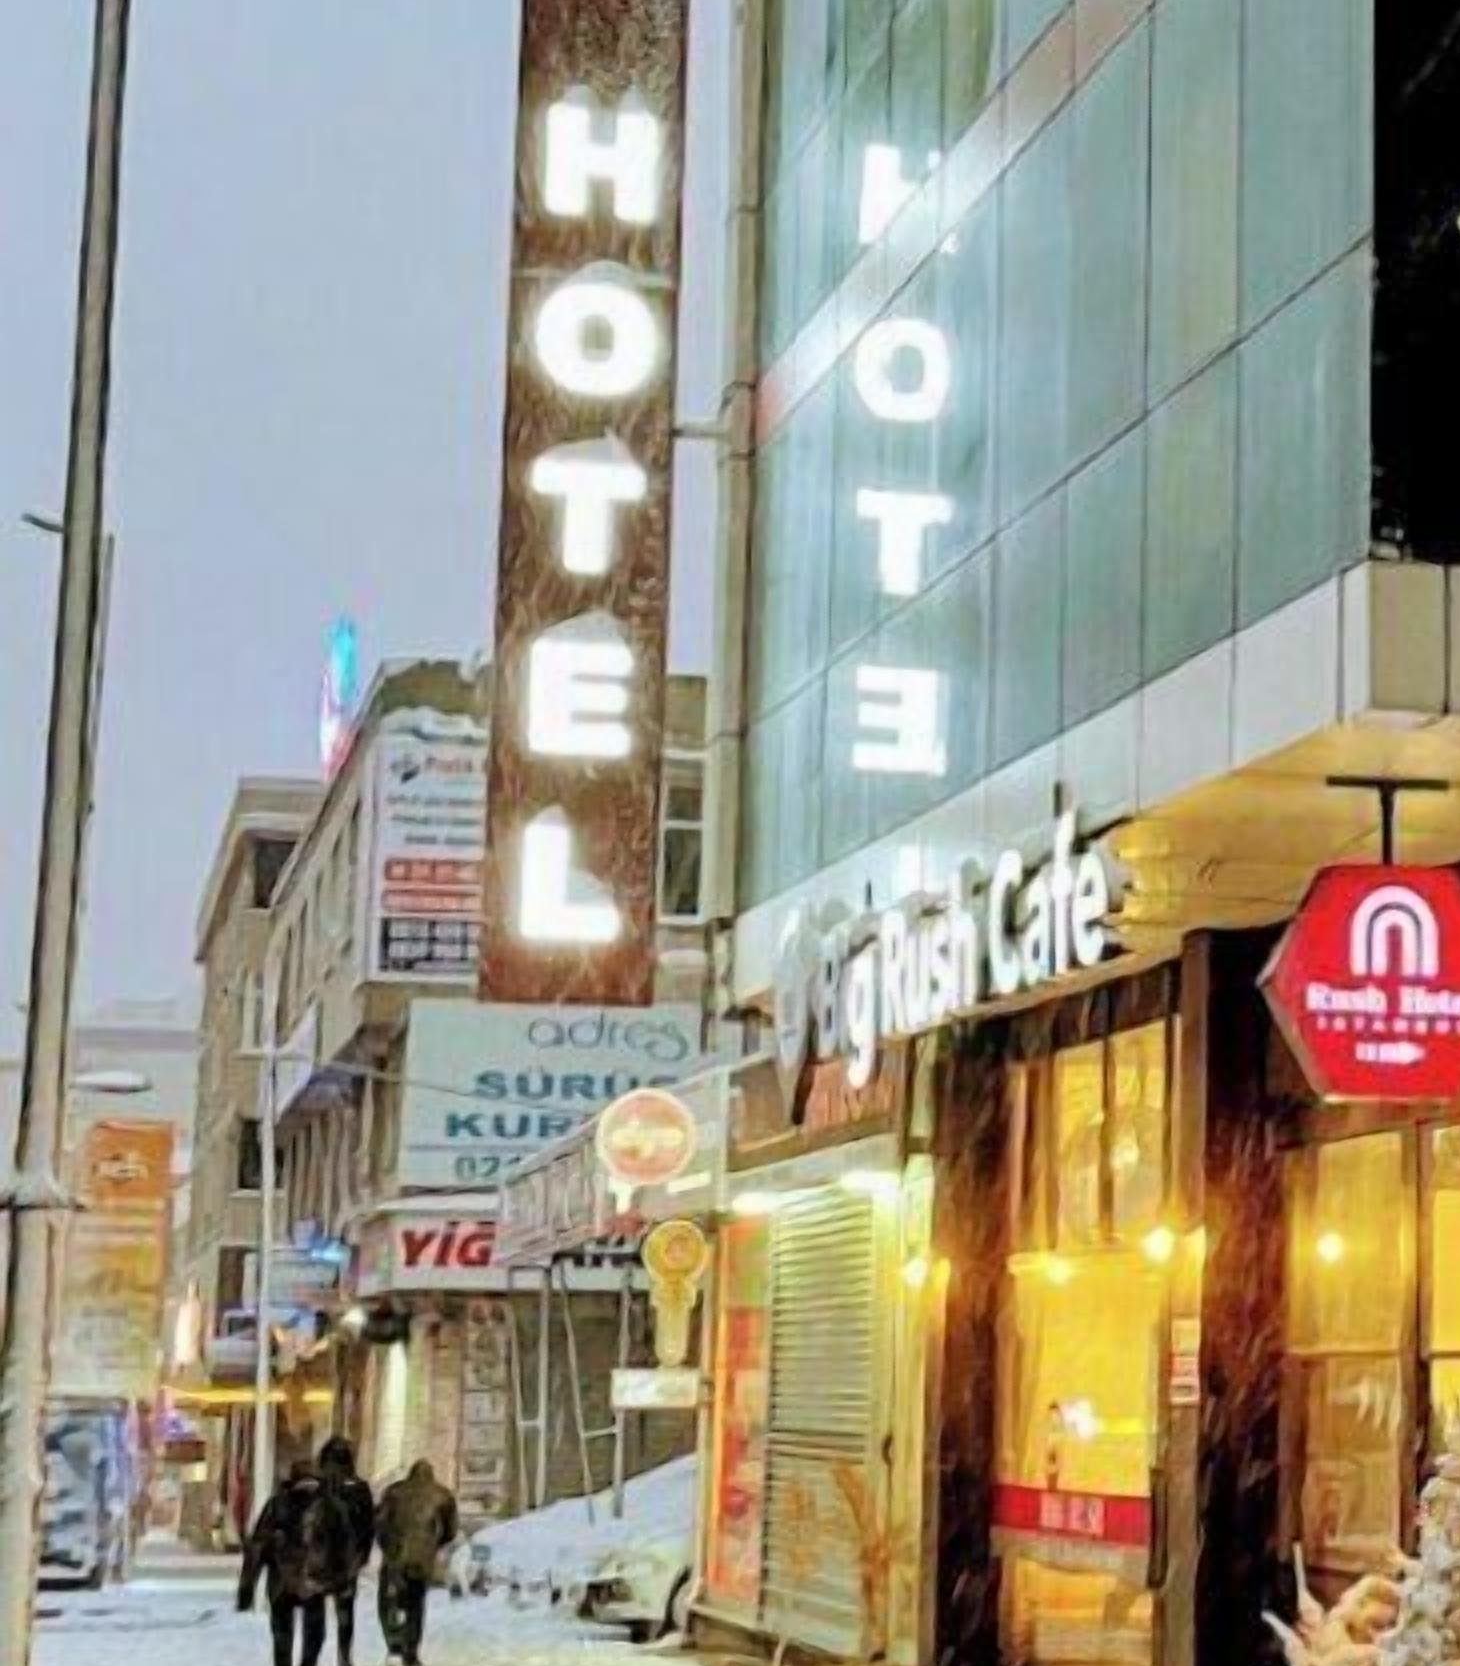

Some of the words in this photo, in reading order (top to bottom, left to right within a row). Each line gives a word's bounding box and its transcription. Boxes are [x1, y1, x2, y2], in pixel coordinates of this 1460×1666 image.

[518, 98, 660, 943] HOTEL
[880, 868, 979, 1039] Rush
[988, 810, 1108, 994] Cafe
[445, 1112, 574, 1138] KUR
